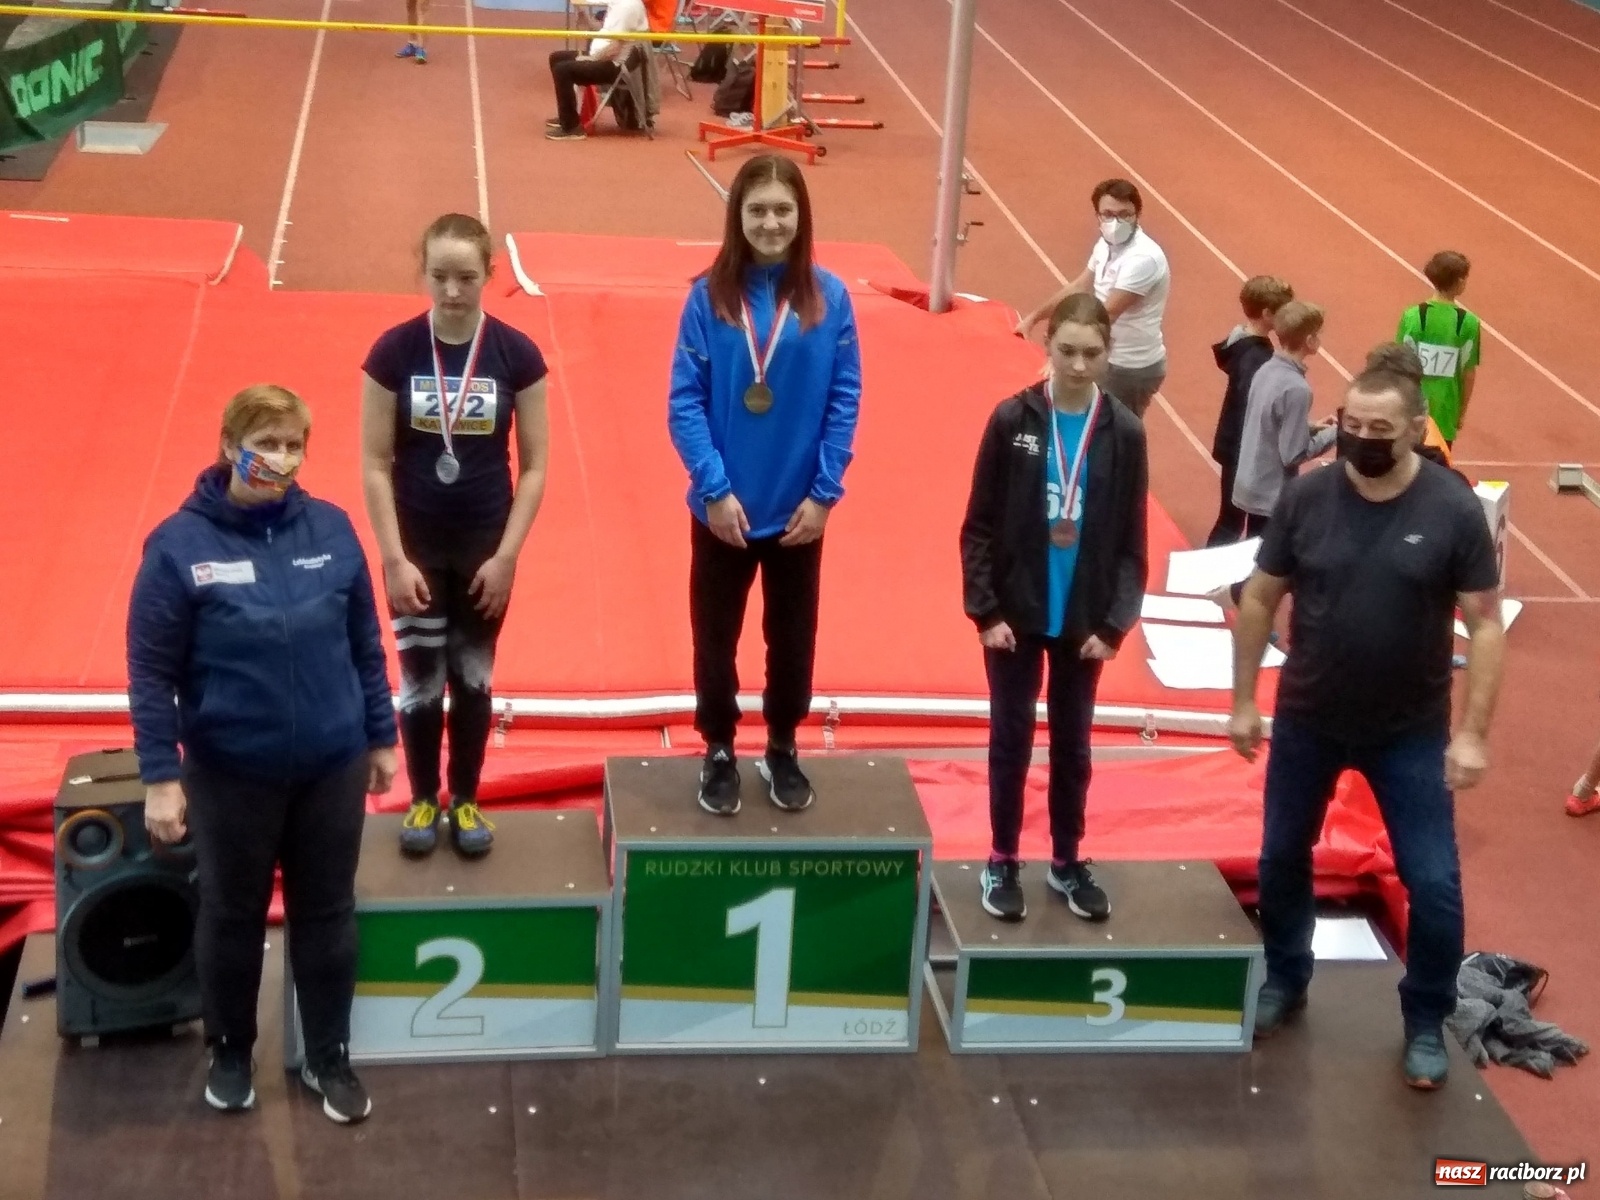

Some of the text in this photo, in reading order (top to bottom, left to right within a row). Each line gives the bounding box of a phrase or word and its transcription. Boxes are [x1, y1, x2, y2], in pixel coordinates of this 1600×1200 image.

[1419, 347, 1455, 374] 517
[418, 419, 488, 431] KAWICE
[645, 859, 904, 876] RUDZKI KLUB SPORTOWY
[725, 887, 796, 1028] 1
[410, 937, 485, 1038] 2
[1086, 968, 1127, 1026] 3
[843, 1018, 897, 1035] ŁÓDŹ
